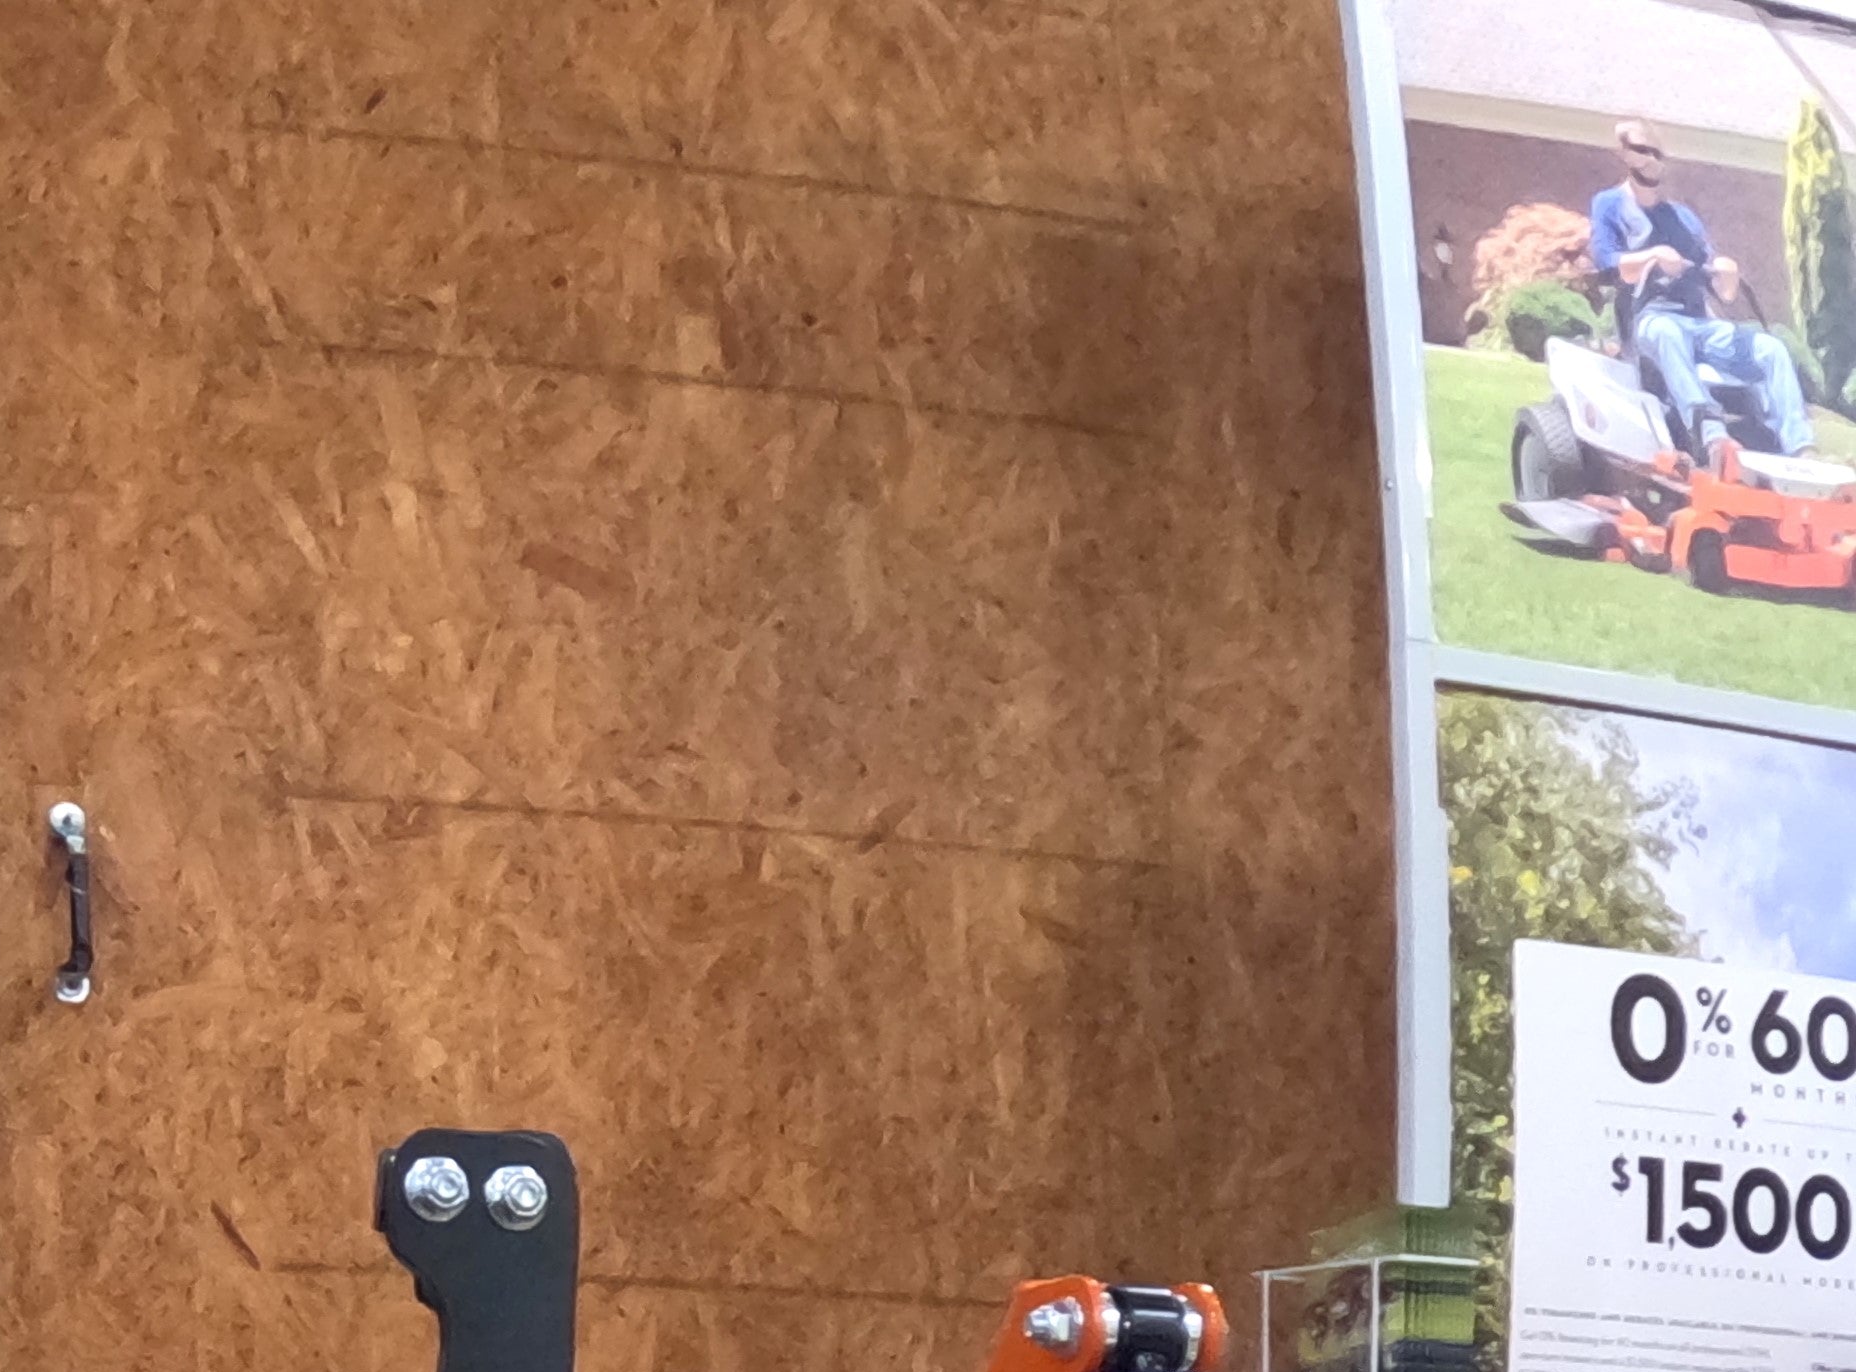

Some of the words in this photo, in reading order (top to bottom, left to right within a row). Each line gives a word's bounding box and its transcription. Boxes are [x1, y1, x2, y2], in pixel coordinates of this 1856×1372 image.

[1750, 988, 1856, 1083] 60
[1692, 1039, 1735, 1059] FOR
[1750, 1082, 1856, 1105] MONTH
[1604, 1126, 1697, 1147] INSTANT
